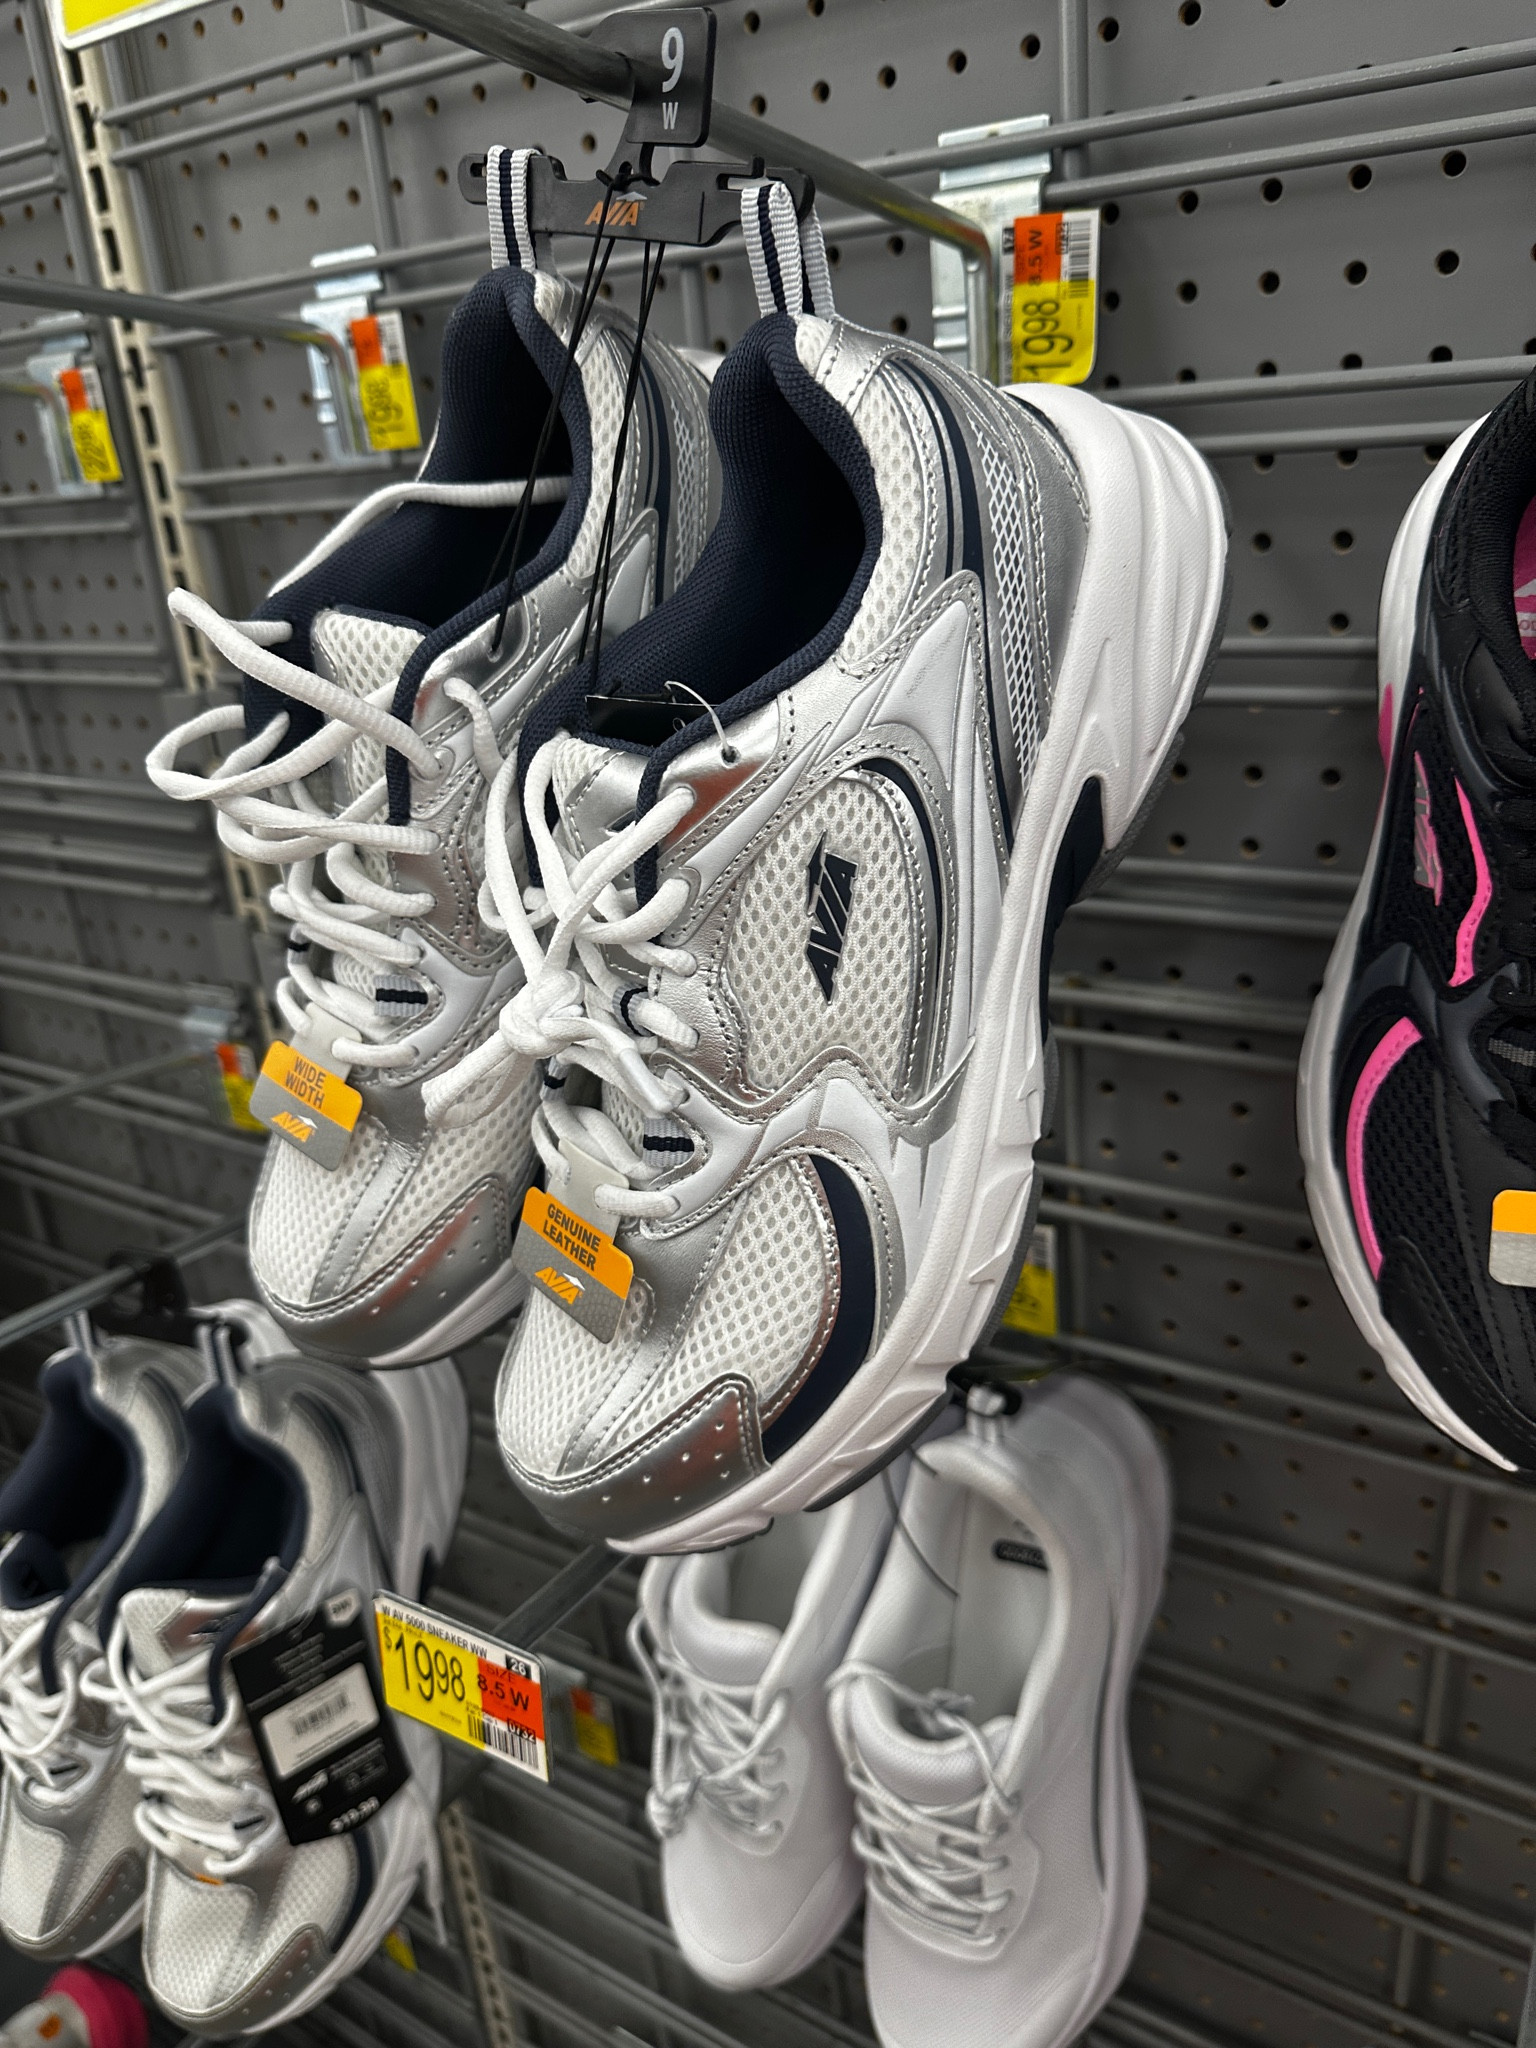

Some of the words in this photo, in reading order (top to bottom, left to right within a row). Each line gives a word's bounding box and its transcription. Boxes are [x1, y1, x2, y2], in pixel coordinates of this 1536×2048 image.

[661, 26, 685, 93] 9
[662, 101, 679, 130] W
[584, 201, 640, 226] AVIA
[806, 846, 859, 1005] AVIA
[285, 1070, 325, 1109] WIDTH
[294, 1056, 326, 1089] WIDE
[271, 1111, 313, 1142] AVIA
[542, 1219, 597, 1272] LEATHER
[547, 1203, 601, 1253] GENUINE
[534, 1266, 581, 1305] AVIA
[405, 1614, 426, 1631] 5000
[427, 1623, 469, 1650] SNEAKER
[470, 1641, 488, 1659] WW
[486, 1663, 517, 1683] SIZE
[510, 1658, 526, 1674] 26
[477, 1674, 506, 1700] 8.5
[511, 1687, 530, 1712] W
